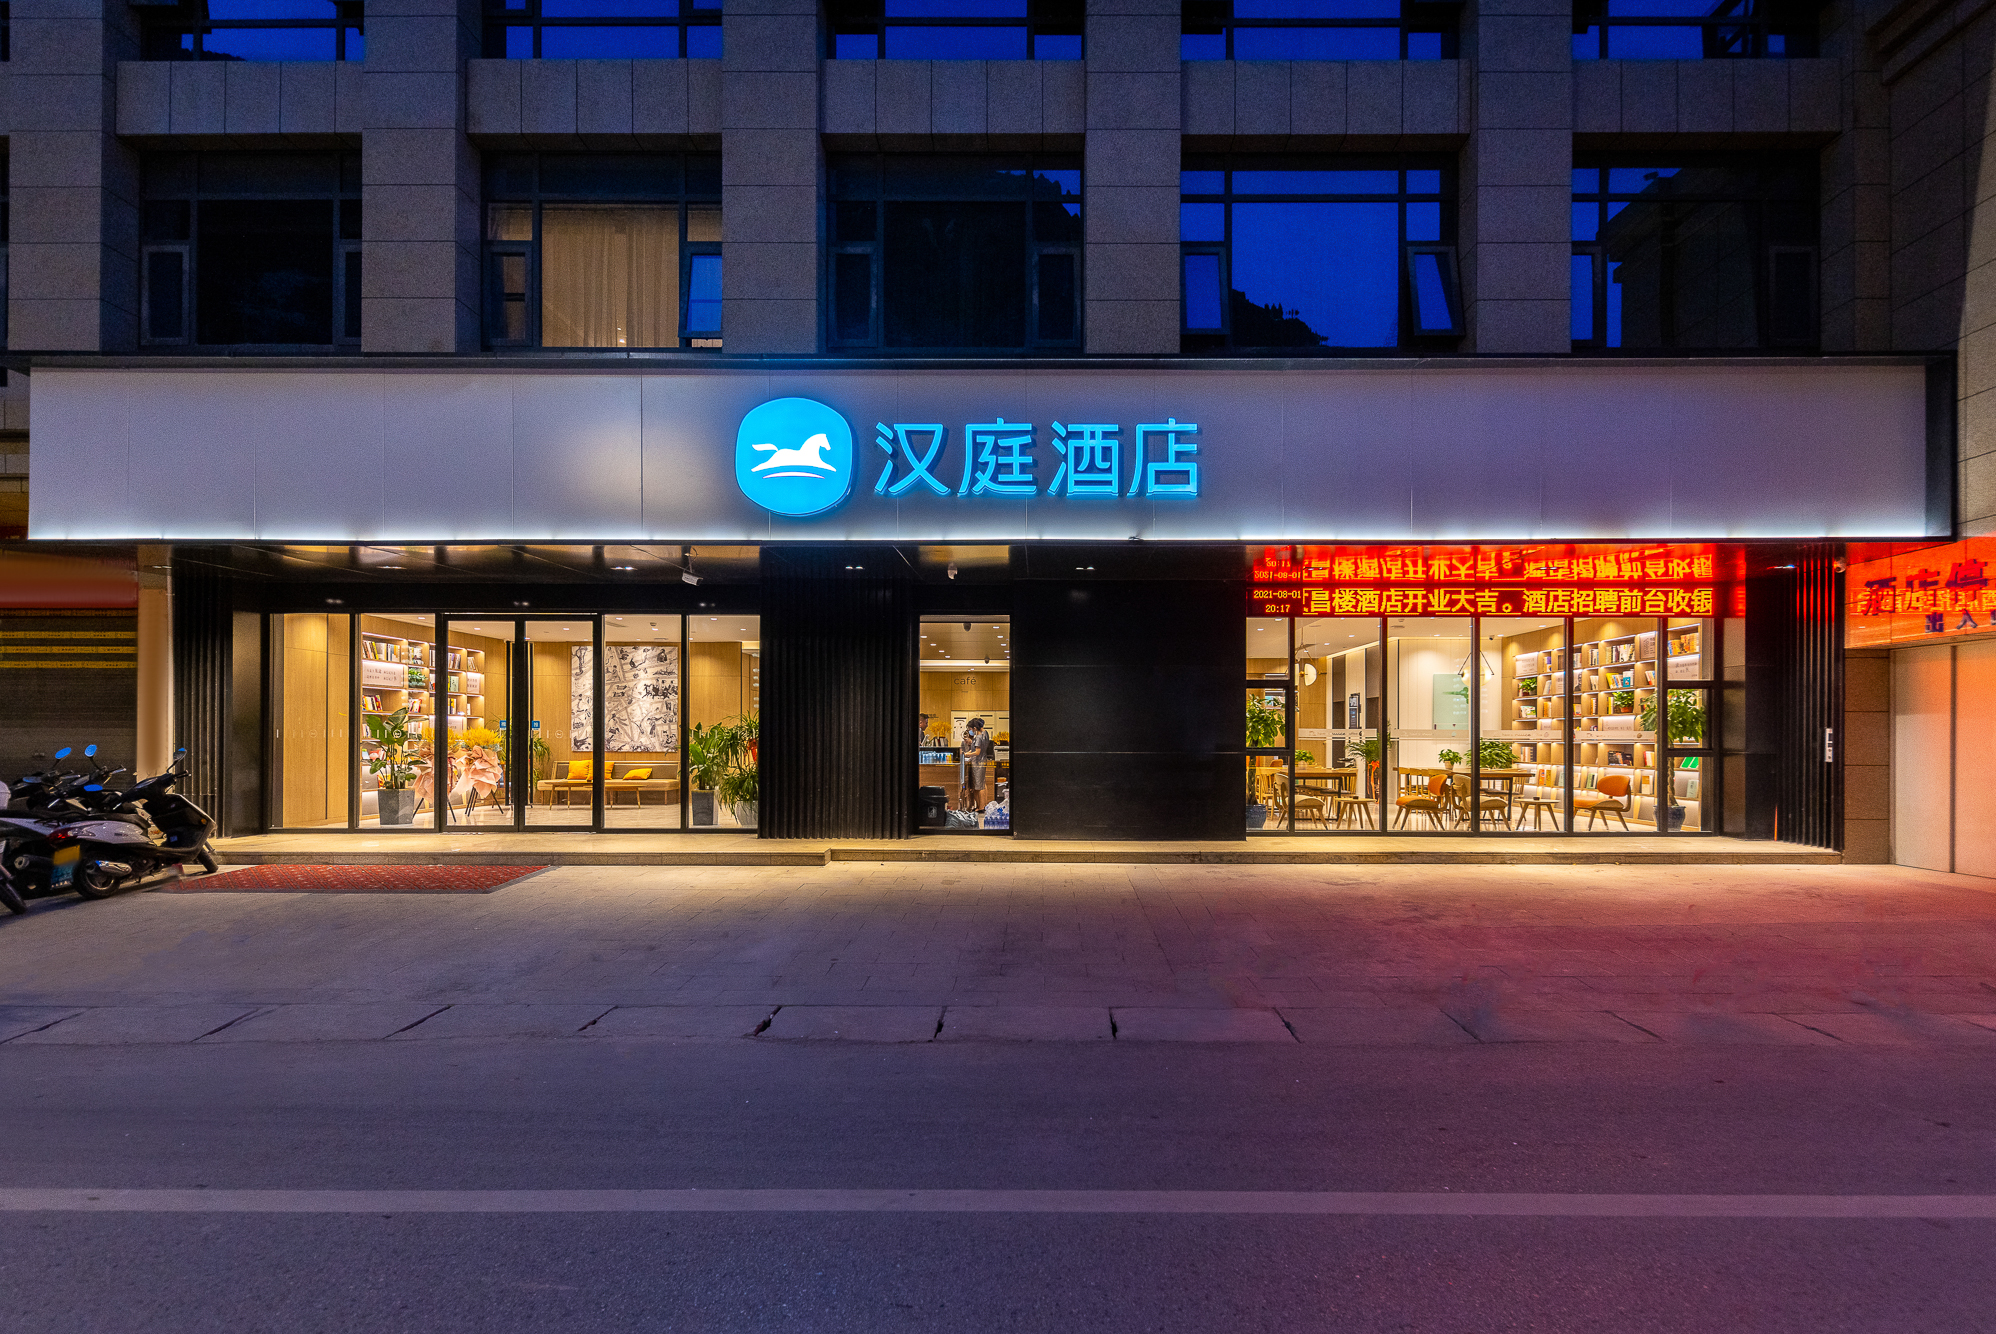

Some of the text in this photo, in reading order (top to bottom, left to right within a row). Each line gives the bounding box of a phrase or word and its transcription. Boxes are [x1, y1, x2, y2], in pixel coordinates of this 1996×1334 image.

[873, 417, 1200, 498] 汉庭酒店
[1253, 590, 1302, 600] 2021-08-01
[1303, 588, 1713, 613] 昌楼酒店开业大吉。酒店招聘前台收银
[1265, 604, 1291, 613] 20:17
[953, 676, 977, 686] café
